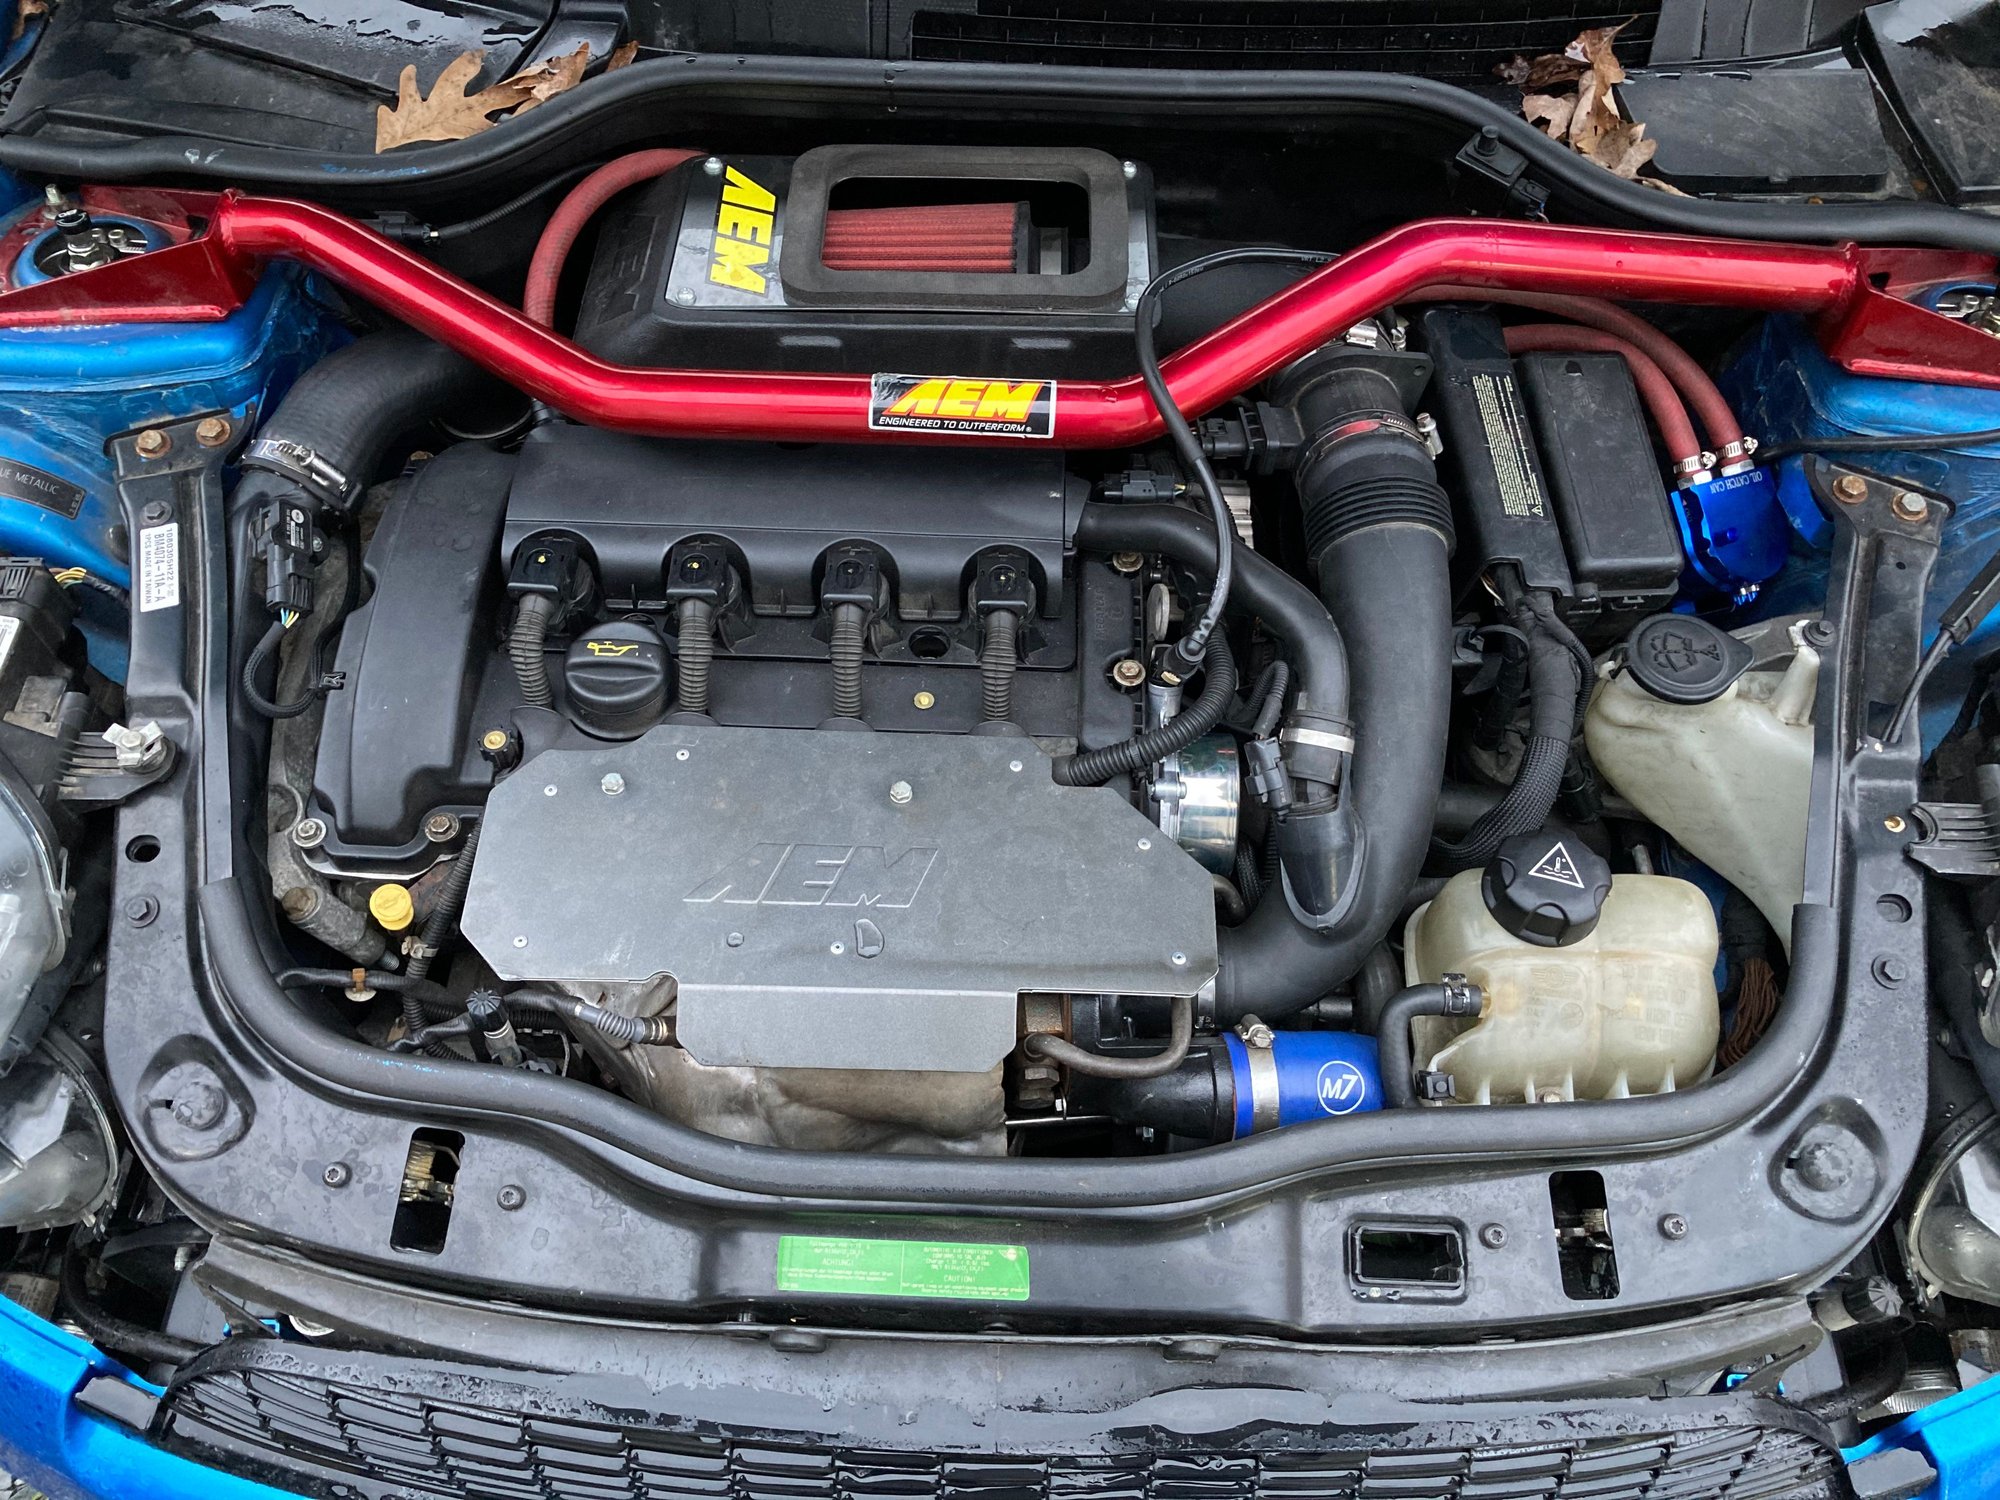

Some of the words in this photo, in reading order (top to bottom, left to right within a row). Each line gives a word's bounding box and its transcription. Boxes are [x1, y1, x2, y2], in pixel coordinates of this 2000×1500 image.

[709, 165, 777, 294] AEM
[883, 378, 1043, 422] AEM
[878, 416, 940, 429] ENGINEERED
[944, 420, 956, 430] TO
[14, 472, 60, 495] METALLIC
[1725, 474, 1750, 490] CATCH
[1749, 471, 1763, 483] OIL
[1709, 482, 1725, 494] CAN
[144, 550, 152, 568] MADE
[153, 532, 166, 602] BM4074-11A-A
[144, 570, 152, 578] IN
[144, 579, 153, 604] TAIWAN
[682, 841, 939, 909] AEM
[1321, 1073, 1358, 1101] M7
[943, 1274, 976, 1283] CAUTION!
